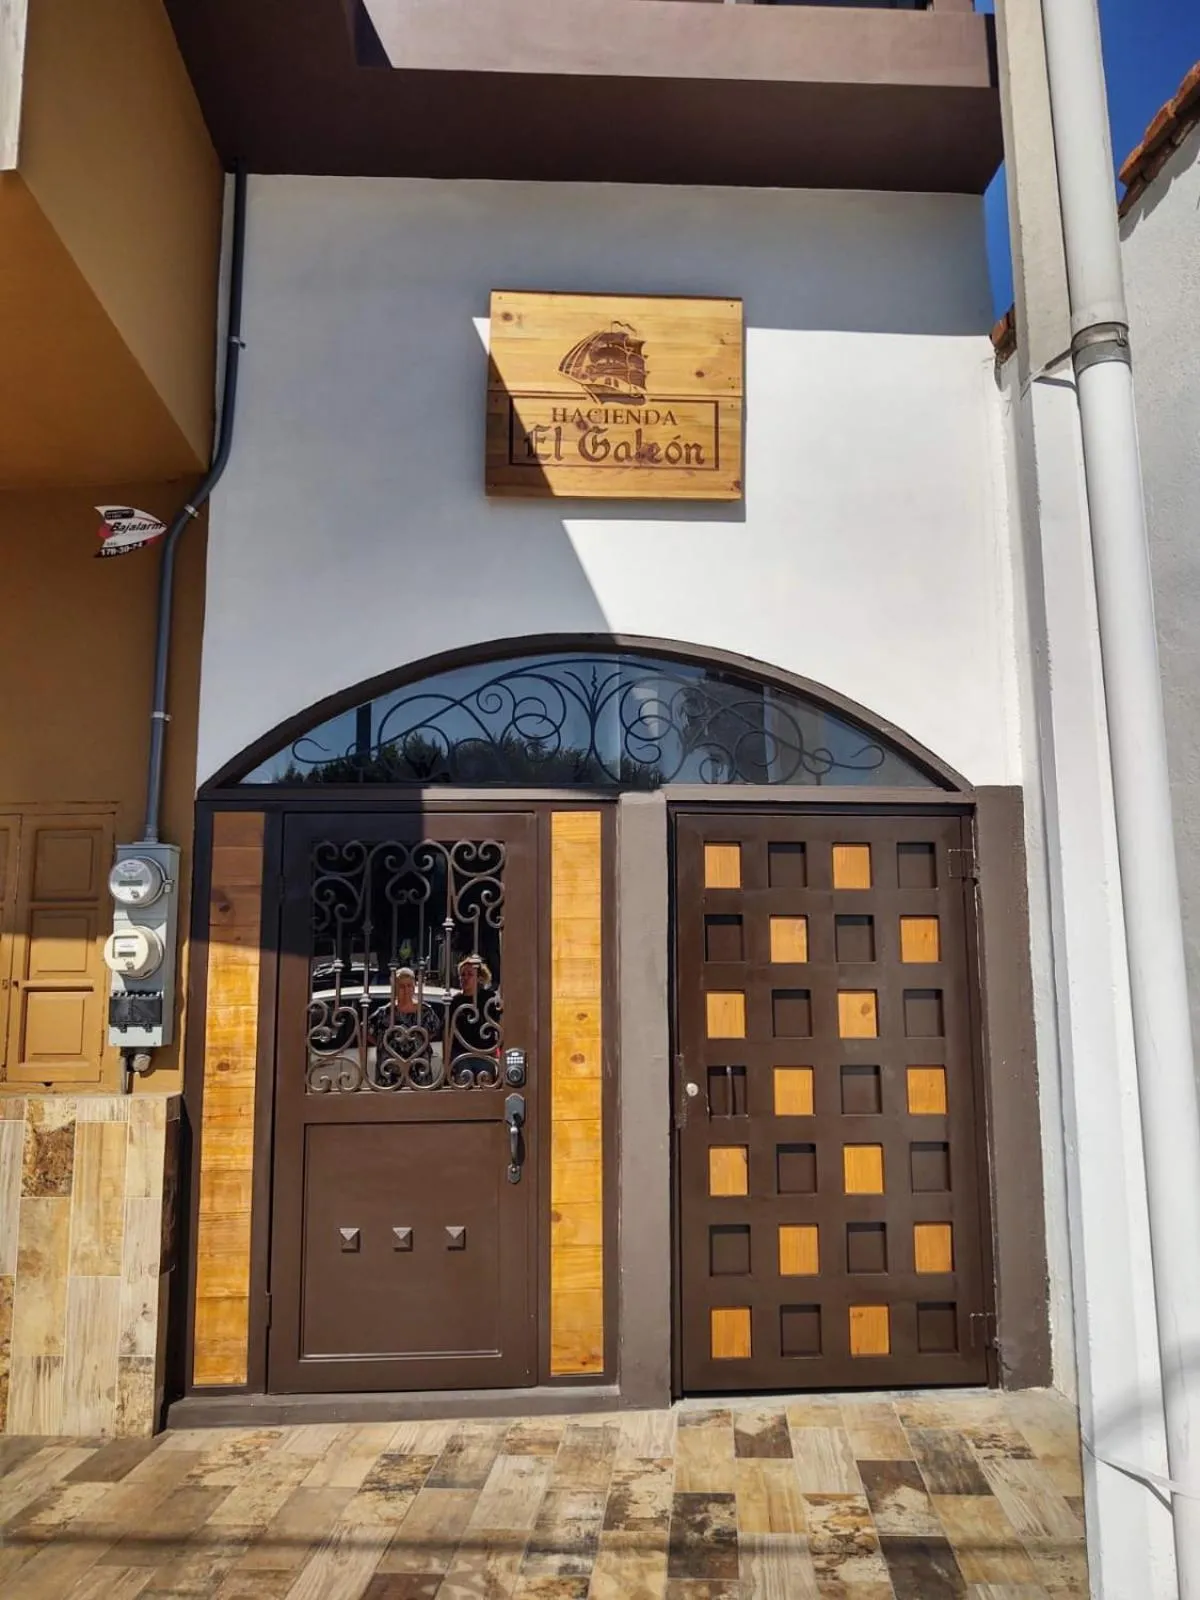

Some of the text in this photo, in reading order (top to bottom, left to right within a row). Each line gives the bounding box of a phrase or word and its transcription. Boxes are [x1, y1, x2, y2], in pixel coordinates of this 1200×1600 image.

[551, 407, 678, 426] HACIENDA
[523, 424, 705, 465] El Galeón
